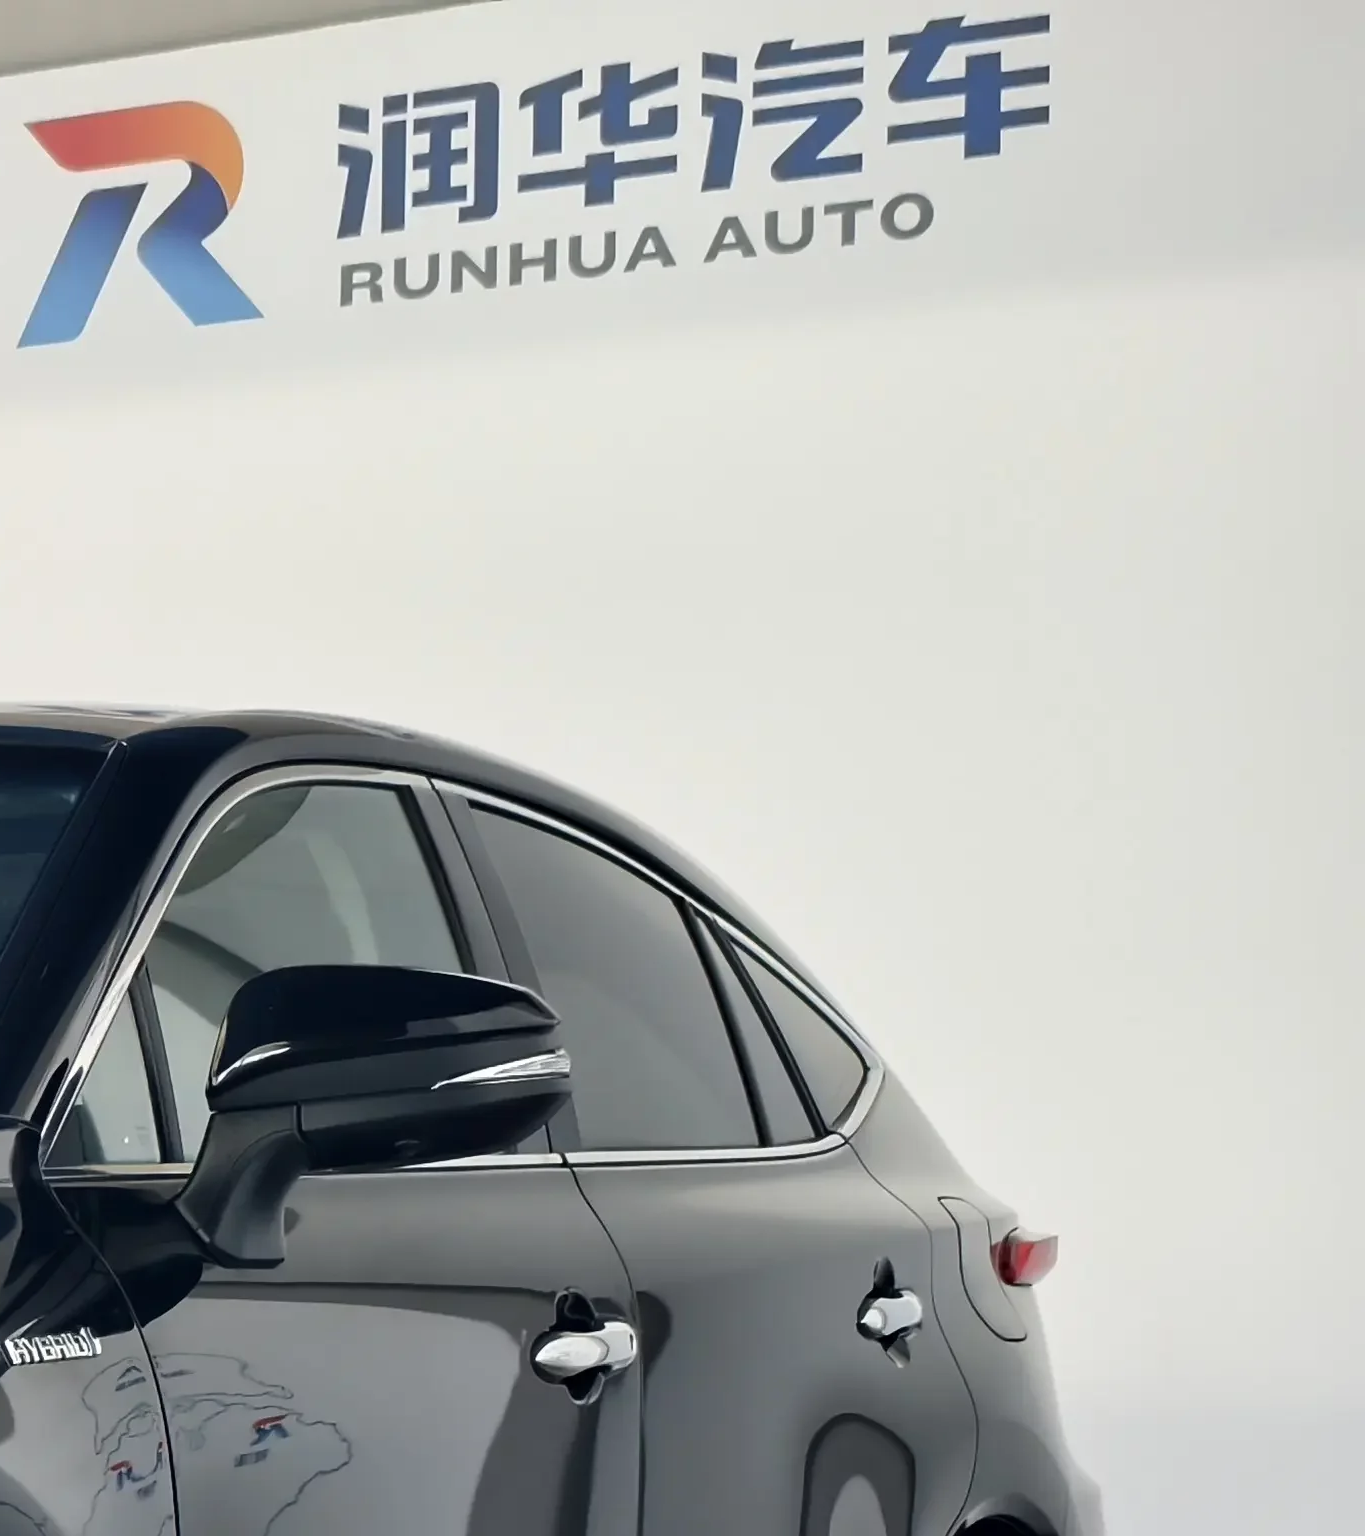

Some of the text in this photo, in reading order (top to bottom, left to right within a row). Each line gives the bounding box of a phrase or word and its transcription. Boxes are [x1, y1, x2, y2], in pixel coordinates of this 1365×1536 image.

[336, 13, 1051, 240] 润华汽车
[339, 192, 935, 308] RUNHUA AUTO
[4, 1330, 93, 1365] HYBRID
